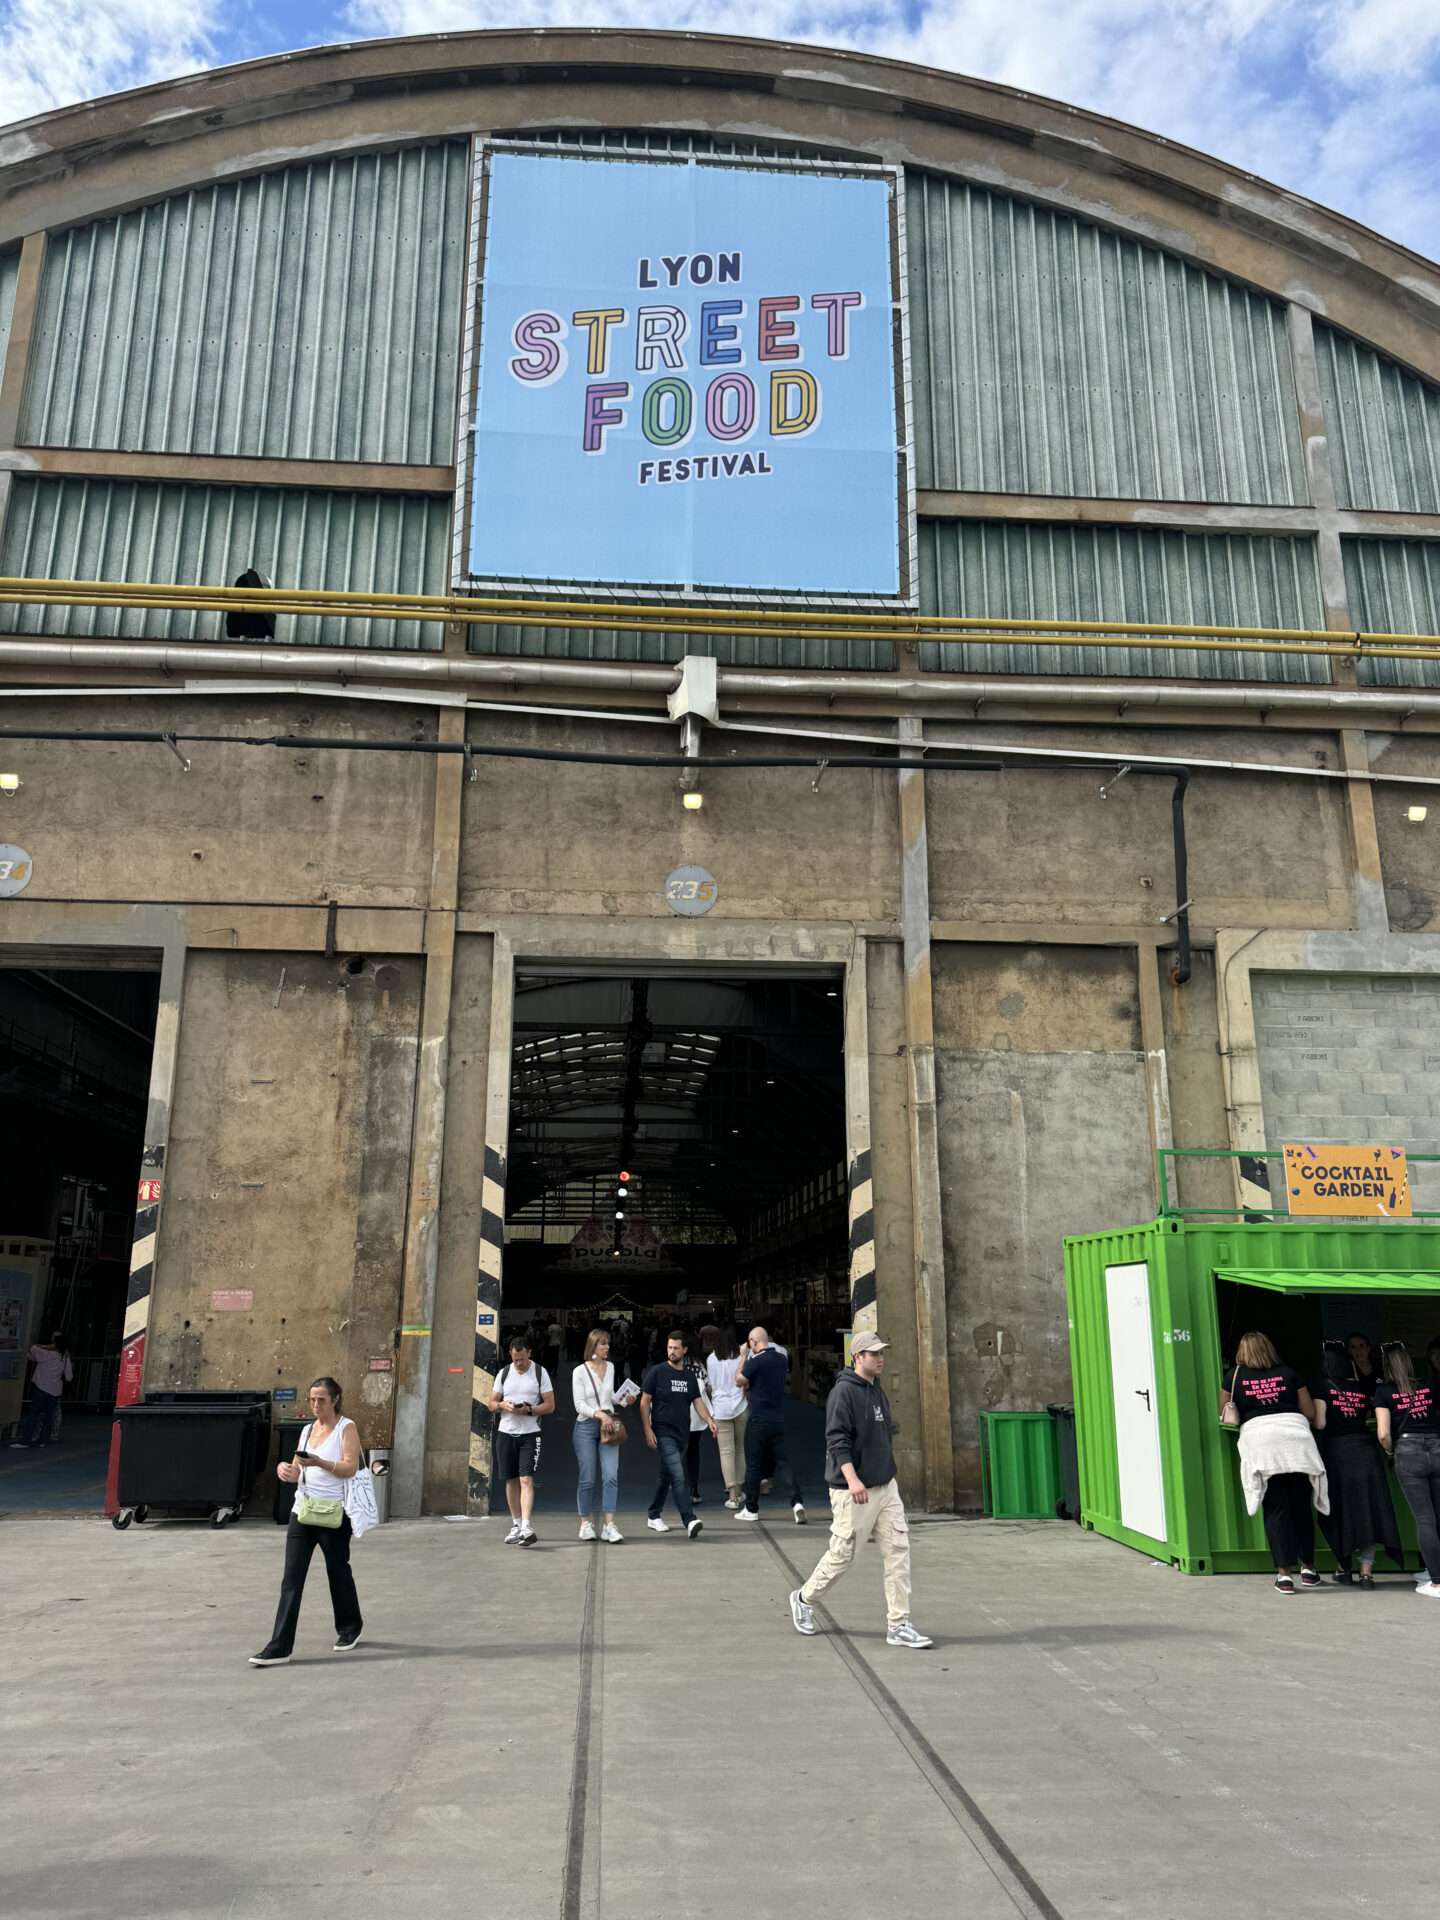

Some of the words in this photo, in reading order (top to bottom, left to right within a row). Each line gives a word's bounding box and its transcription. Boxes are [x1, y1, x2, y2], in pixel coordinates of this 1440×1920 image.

[639, 252, 741, 288] LYON
[511, 291, 863, 382] STREET
[583, 368, 819, 453] FOOD
[639, 452, 771, 484] FESTIVAL
[666, 880, 718, 901] 235
[1301, 1165, 1394, 1181] COCKTAIL
[1313, 1182, 1385, 1197] GARDEN
